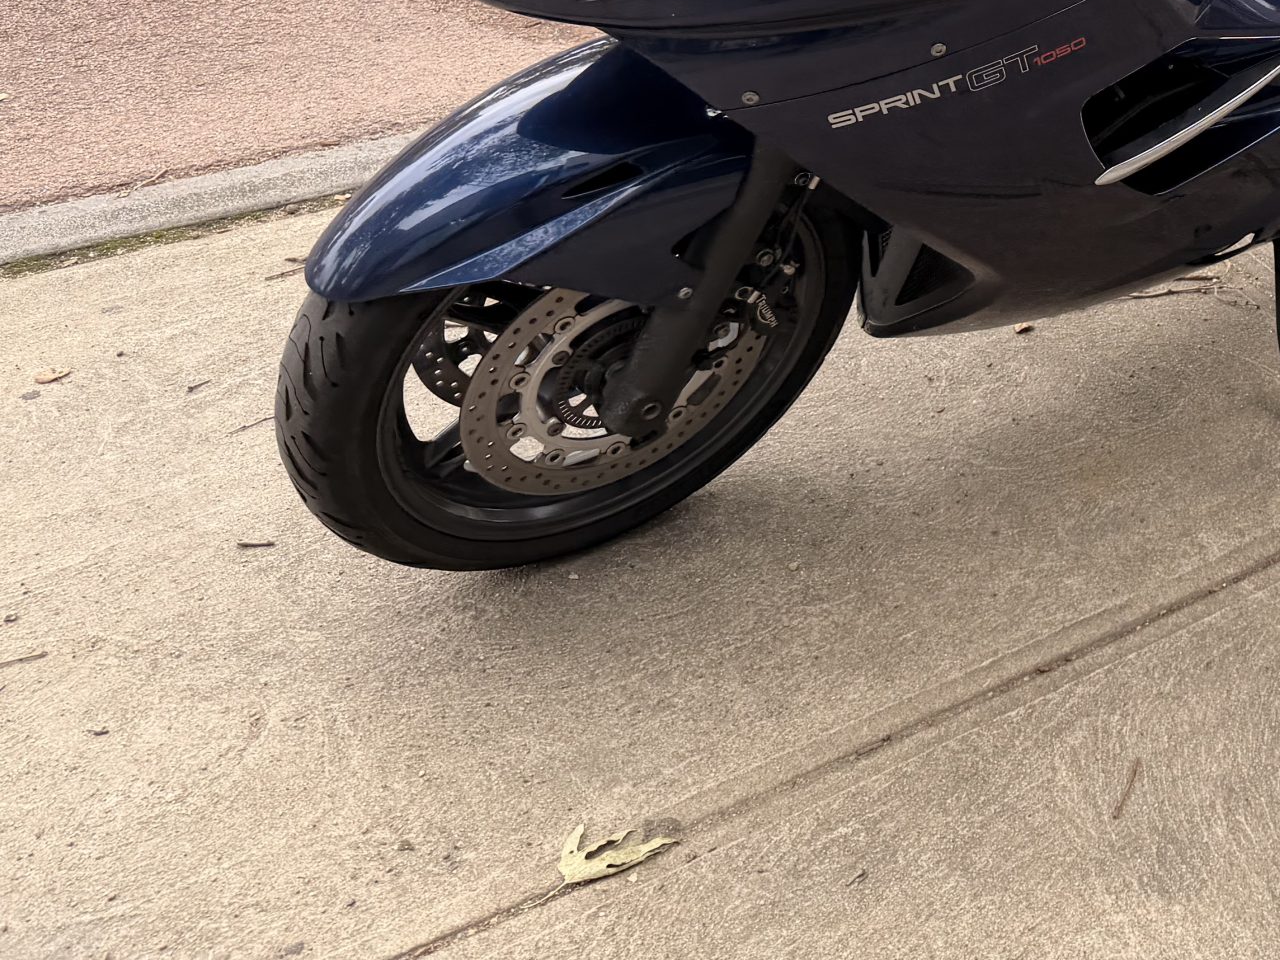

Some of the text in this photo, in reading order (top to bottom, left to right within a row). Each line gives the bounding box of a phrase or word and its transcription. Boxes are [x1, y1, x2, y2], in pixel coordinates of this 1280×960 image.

[827, 37, 1087, 129] SPRINT GT 1050
